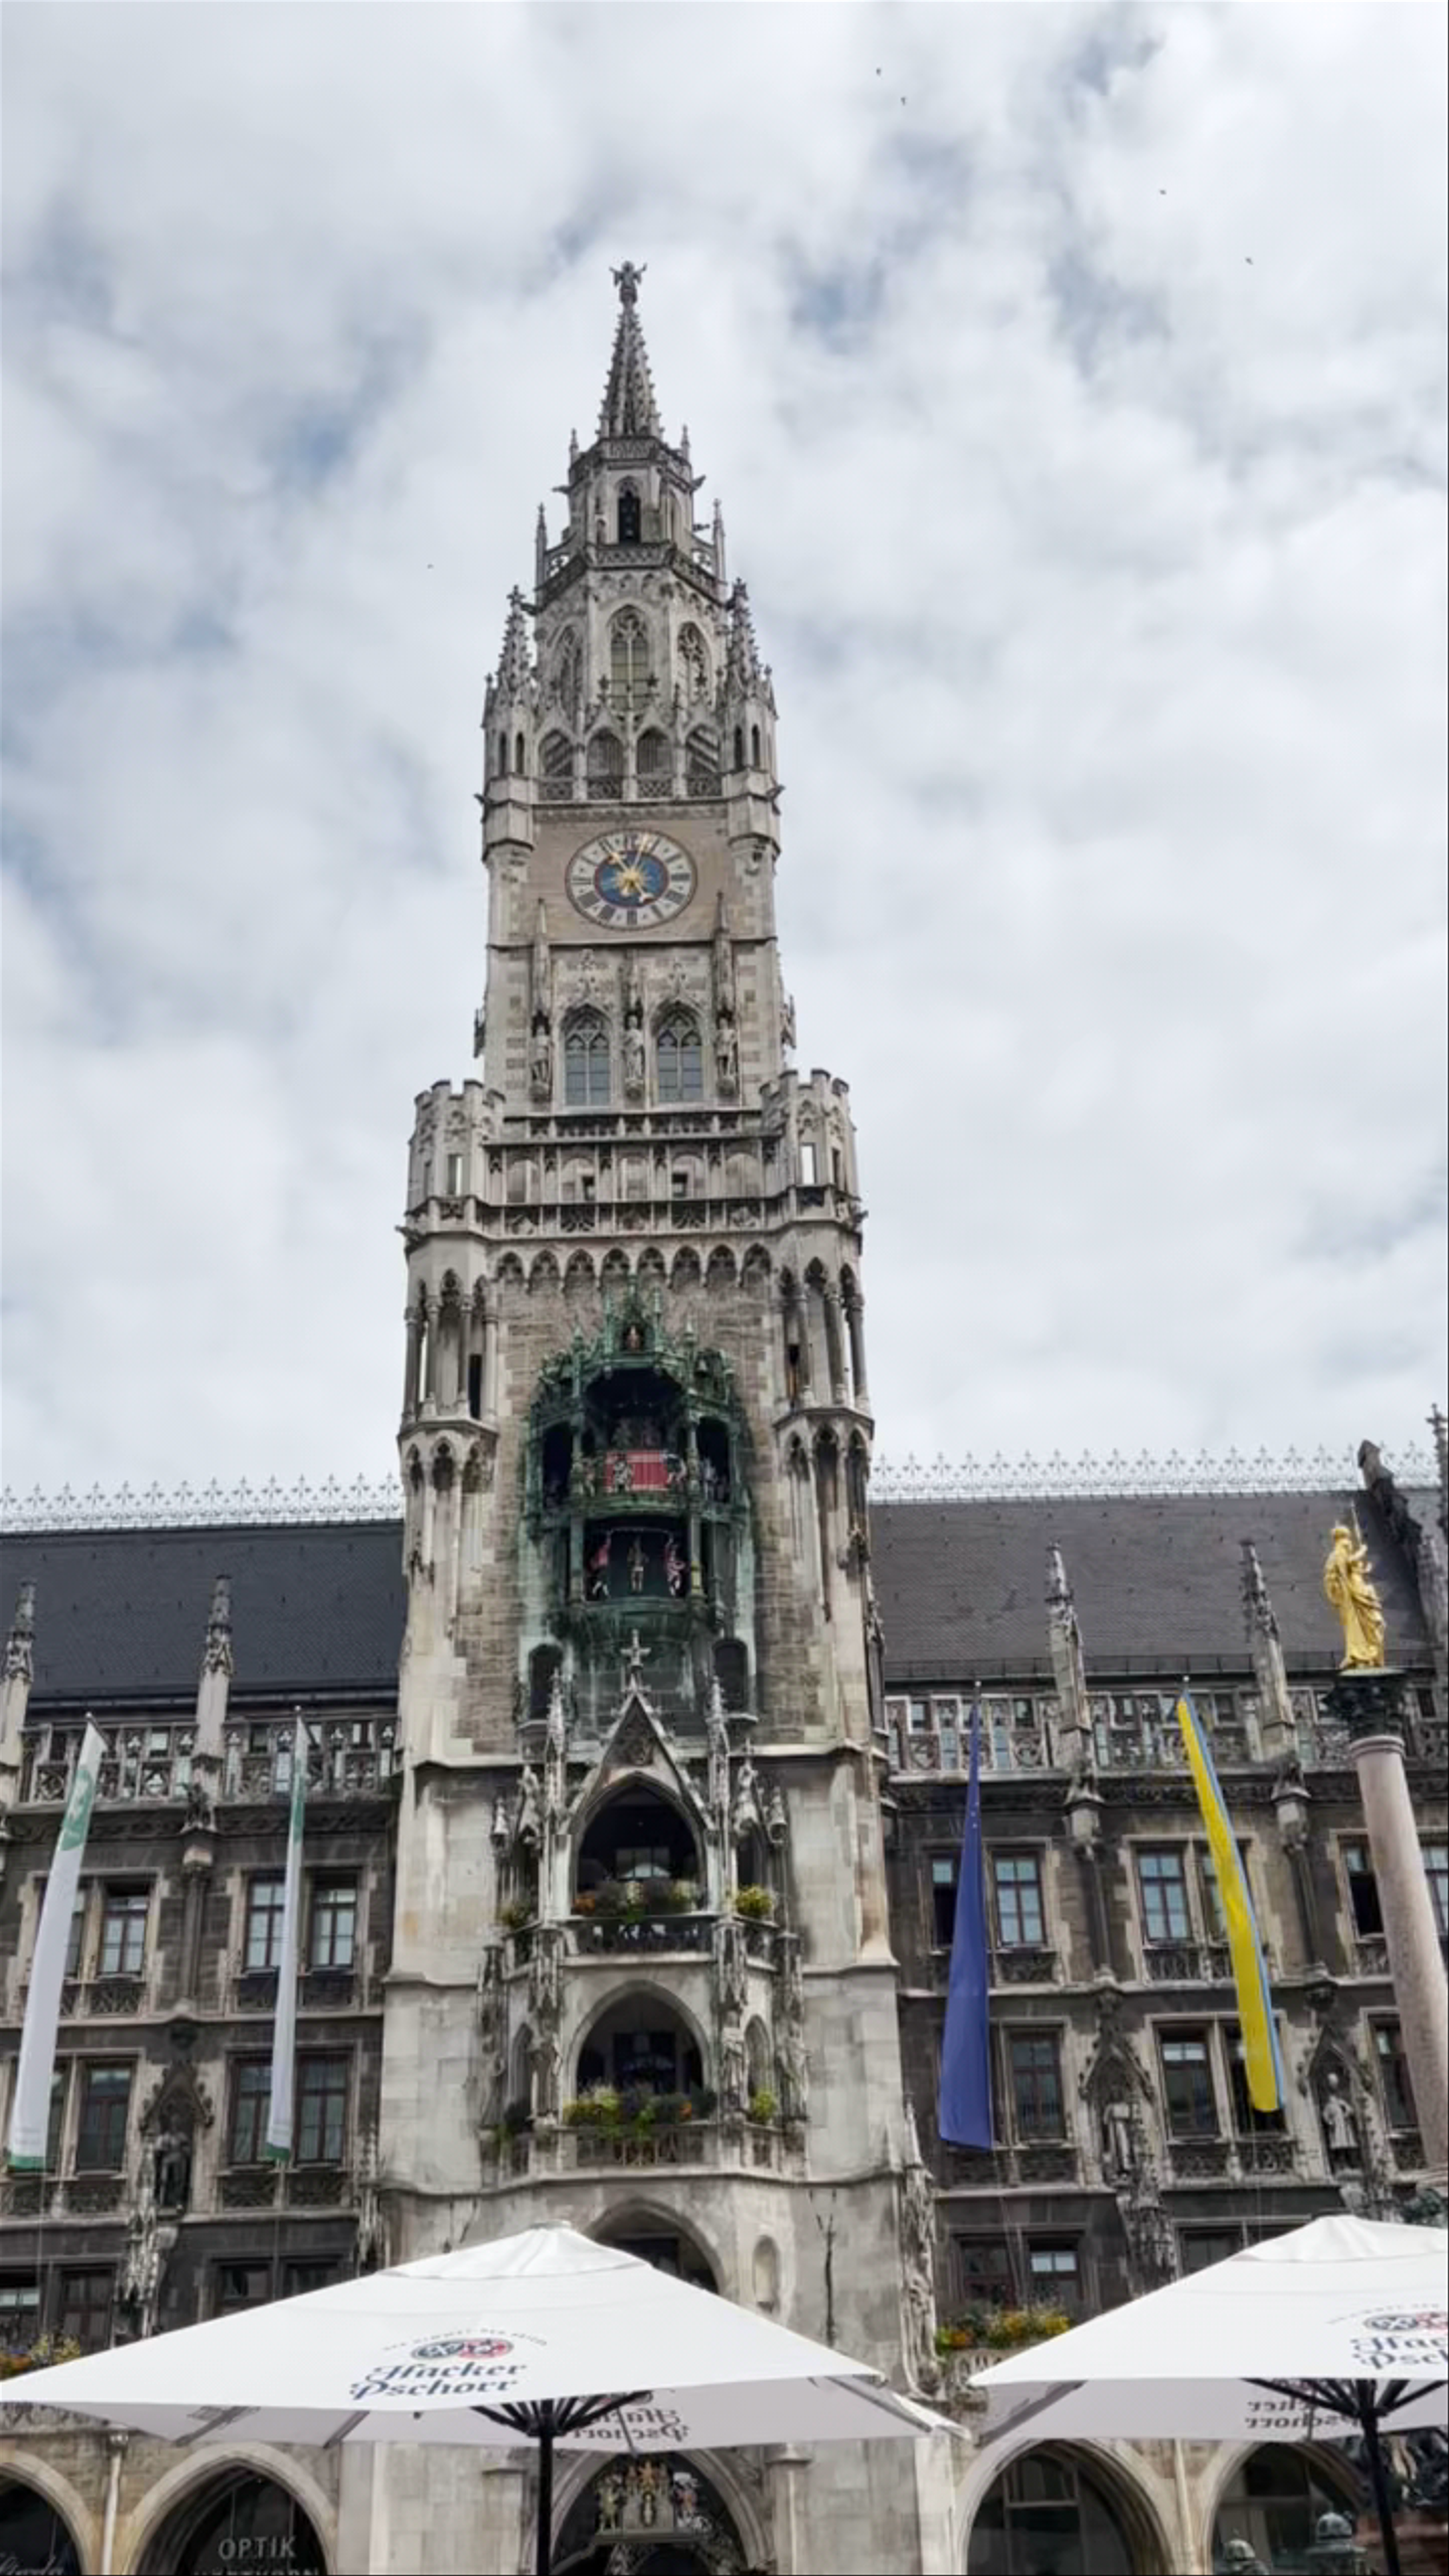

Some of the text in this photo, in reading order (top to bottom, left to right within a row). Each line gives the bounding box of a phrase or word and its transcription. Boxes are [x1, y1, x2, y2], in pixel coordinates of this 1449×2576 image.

[365, 2361, 527, 2380] Hacker
[349, 2379, 518, 2400] Pschorr
[218, 2535, 296, 2560] OPTIK
